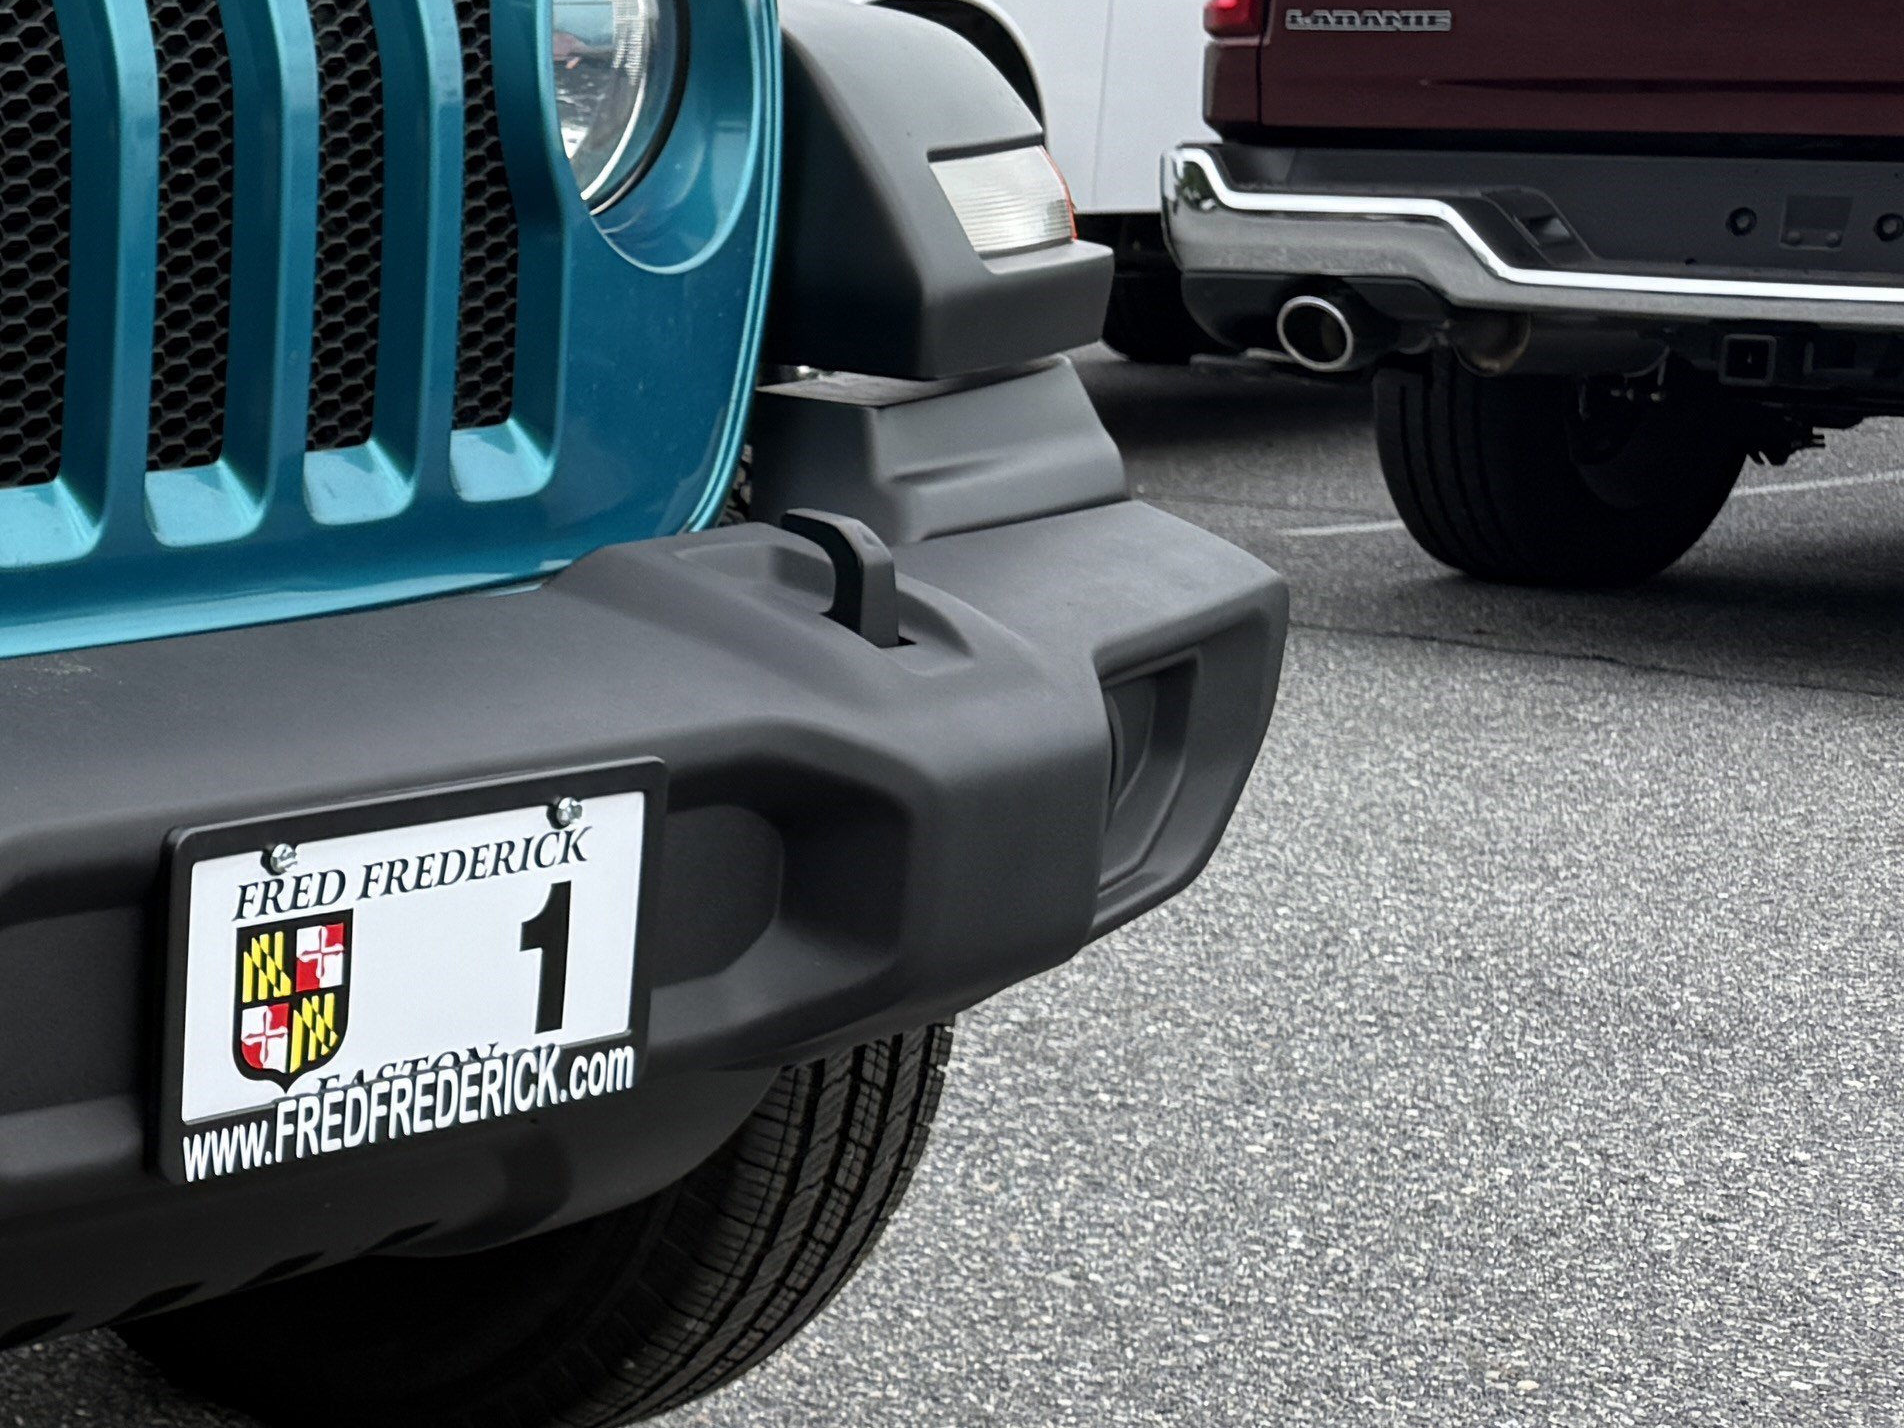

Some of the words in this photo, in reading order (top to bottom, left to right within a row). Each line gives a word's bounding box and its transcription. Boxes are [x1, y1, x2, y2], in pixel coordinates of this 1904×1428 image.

[1286, 9, 1452, 32] LARAMIE
[233, 868, 347, 923] FRED
[357, 826, 592, 901] FREDERICK
[519, 880, 572, 1035] 1
[182, 1045, 635, 1183] www.FREDFREDERICK.com
